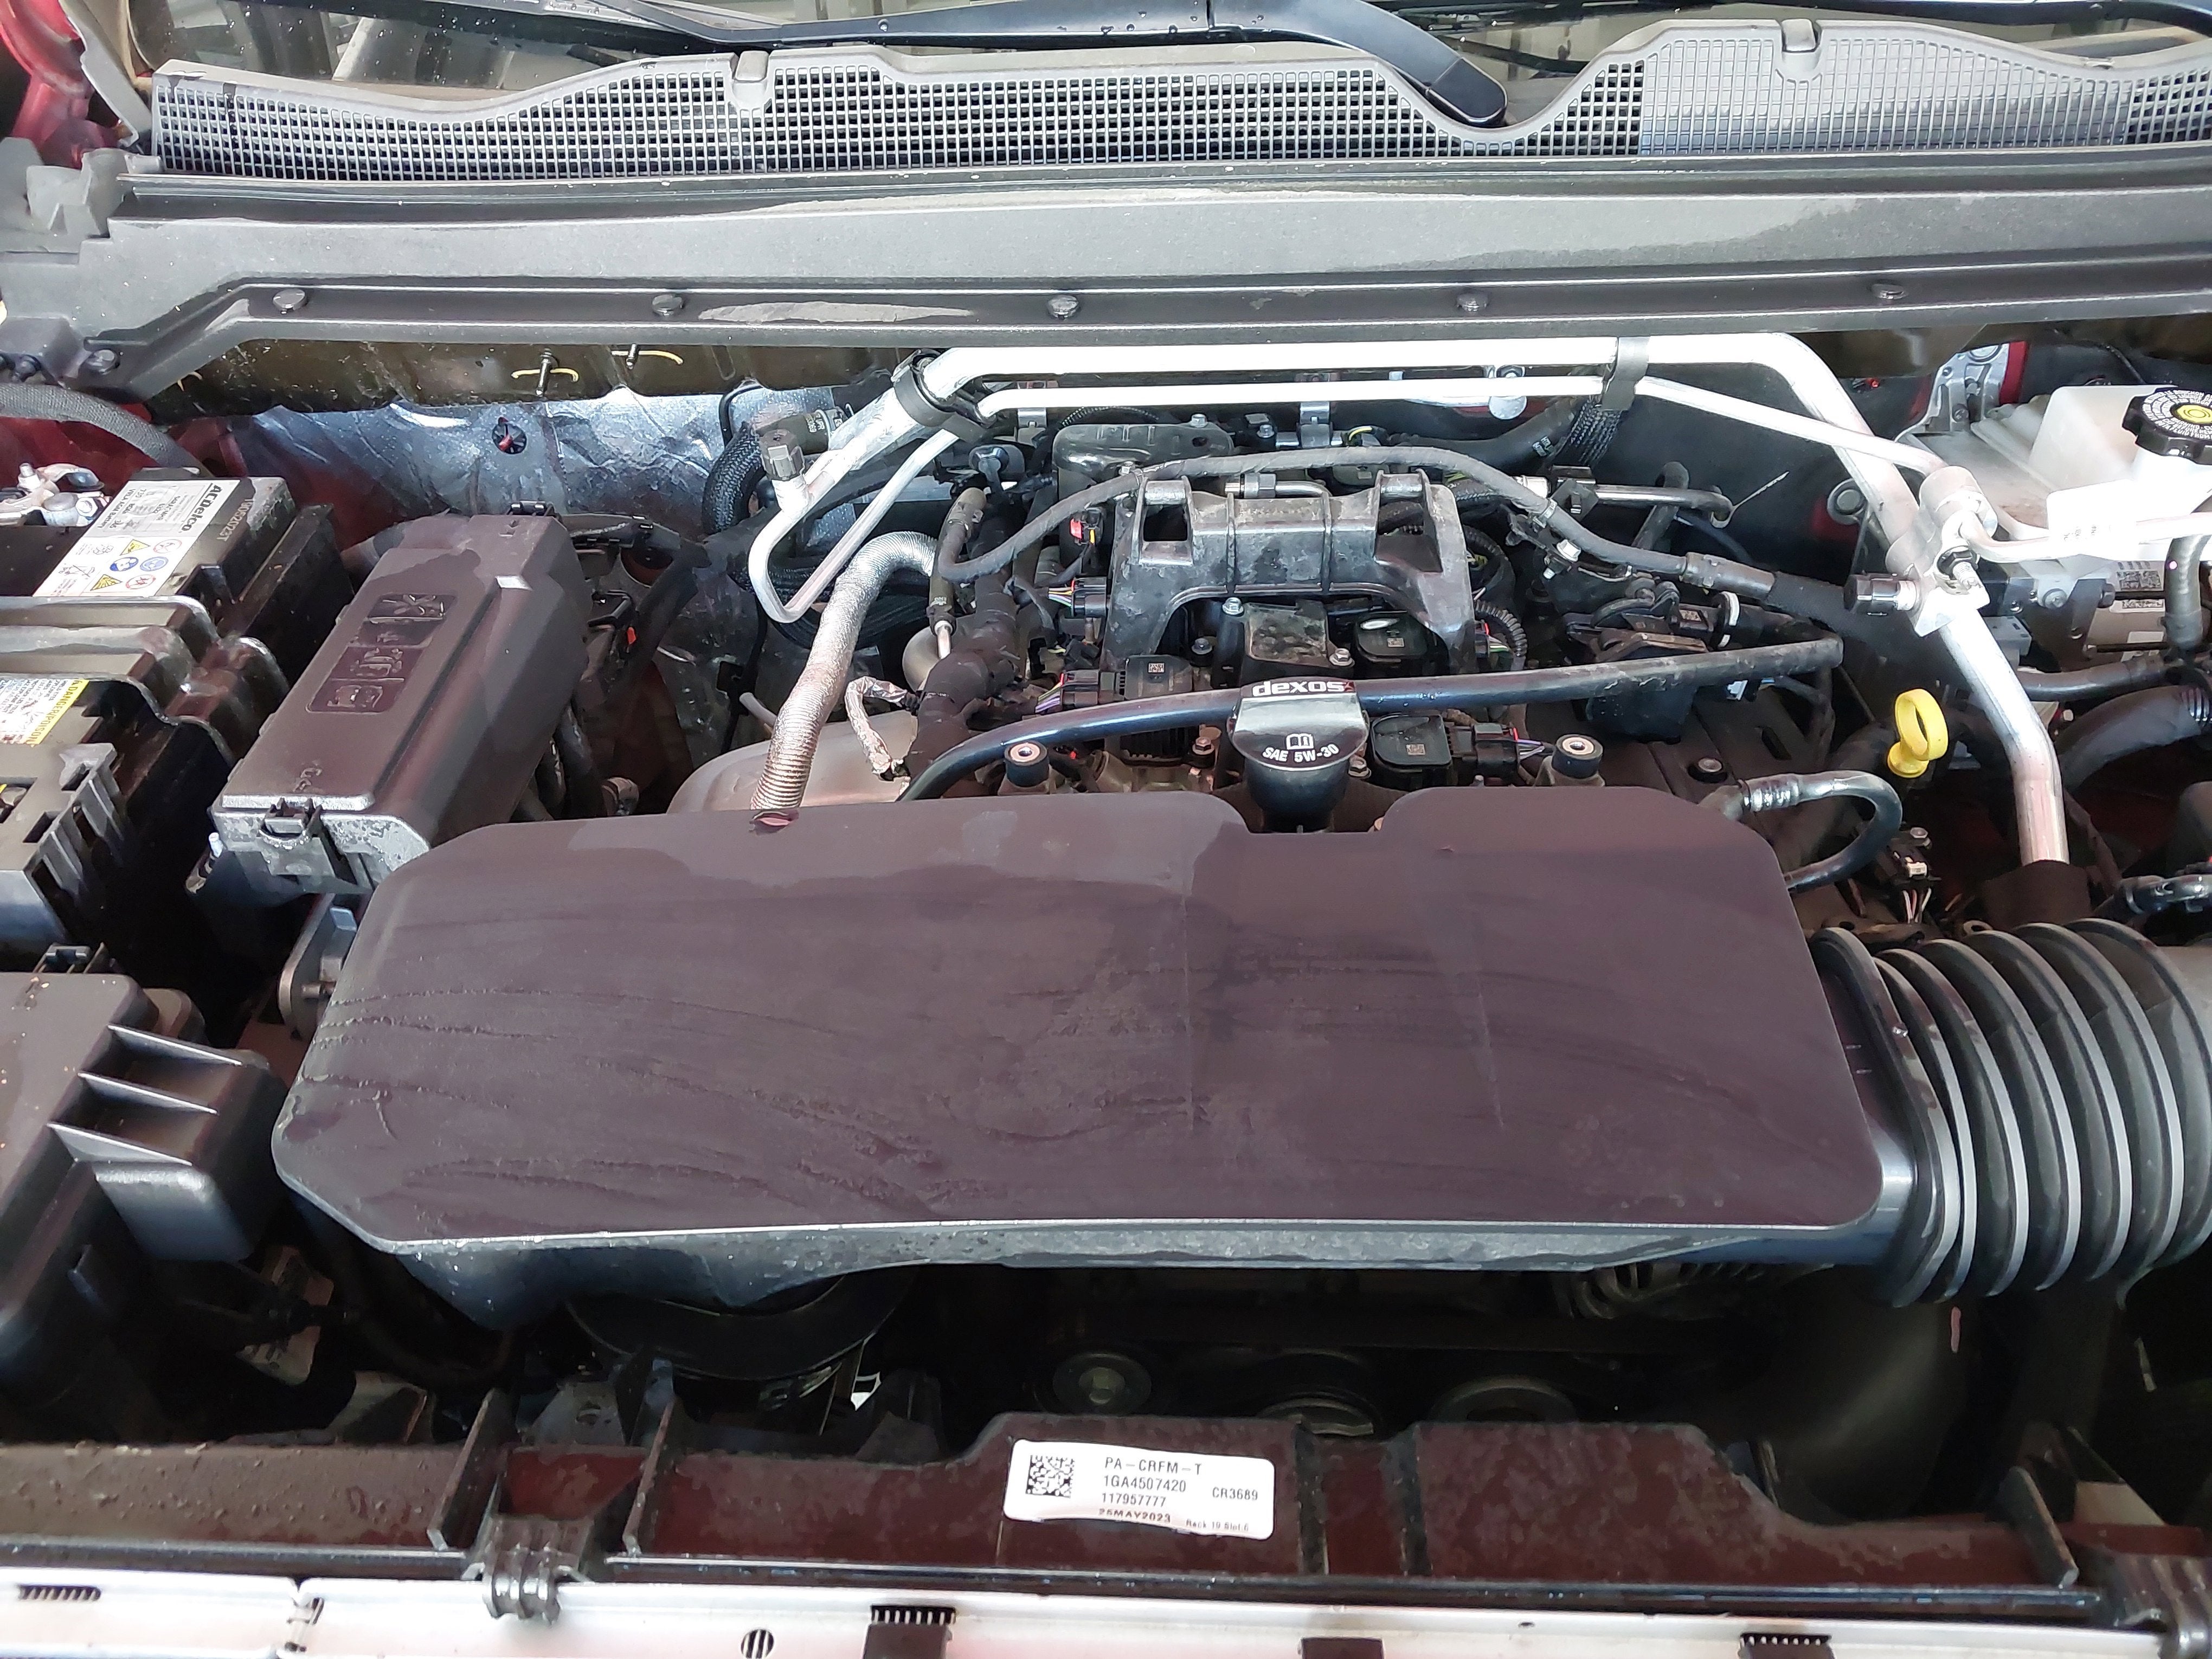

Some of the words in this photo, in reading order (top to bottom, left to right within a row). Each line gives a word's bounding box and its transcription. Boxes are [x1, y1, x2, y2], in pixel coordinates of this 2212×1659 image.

[182, 484, 223, 531] ACDelco
[1252, 681, 1346, 697] dexos
[1263, 747, 1289, 762] SAE
[1294, 744, 1339, 763] 5W-30
[1104, 1475, 1186, 1493] 1GA4507420
[1102, 1493, 1166, 1507] 117957777
[1212, 1487, 1258, 1501] CR3689
